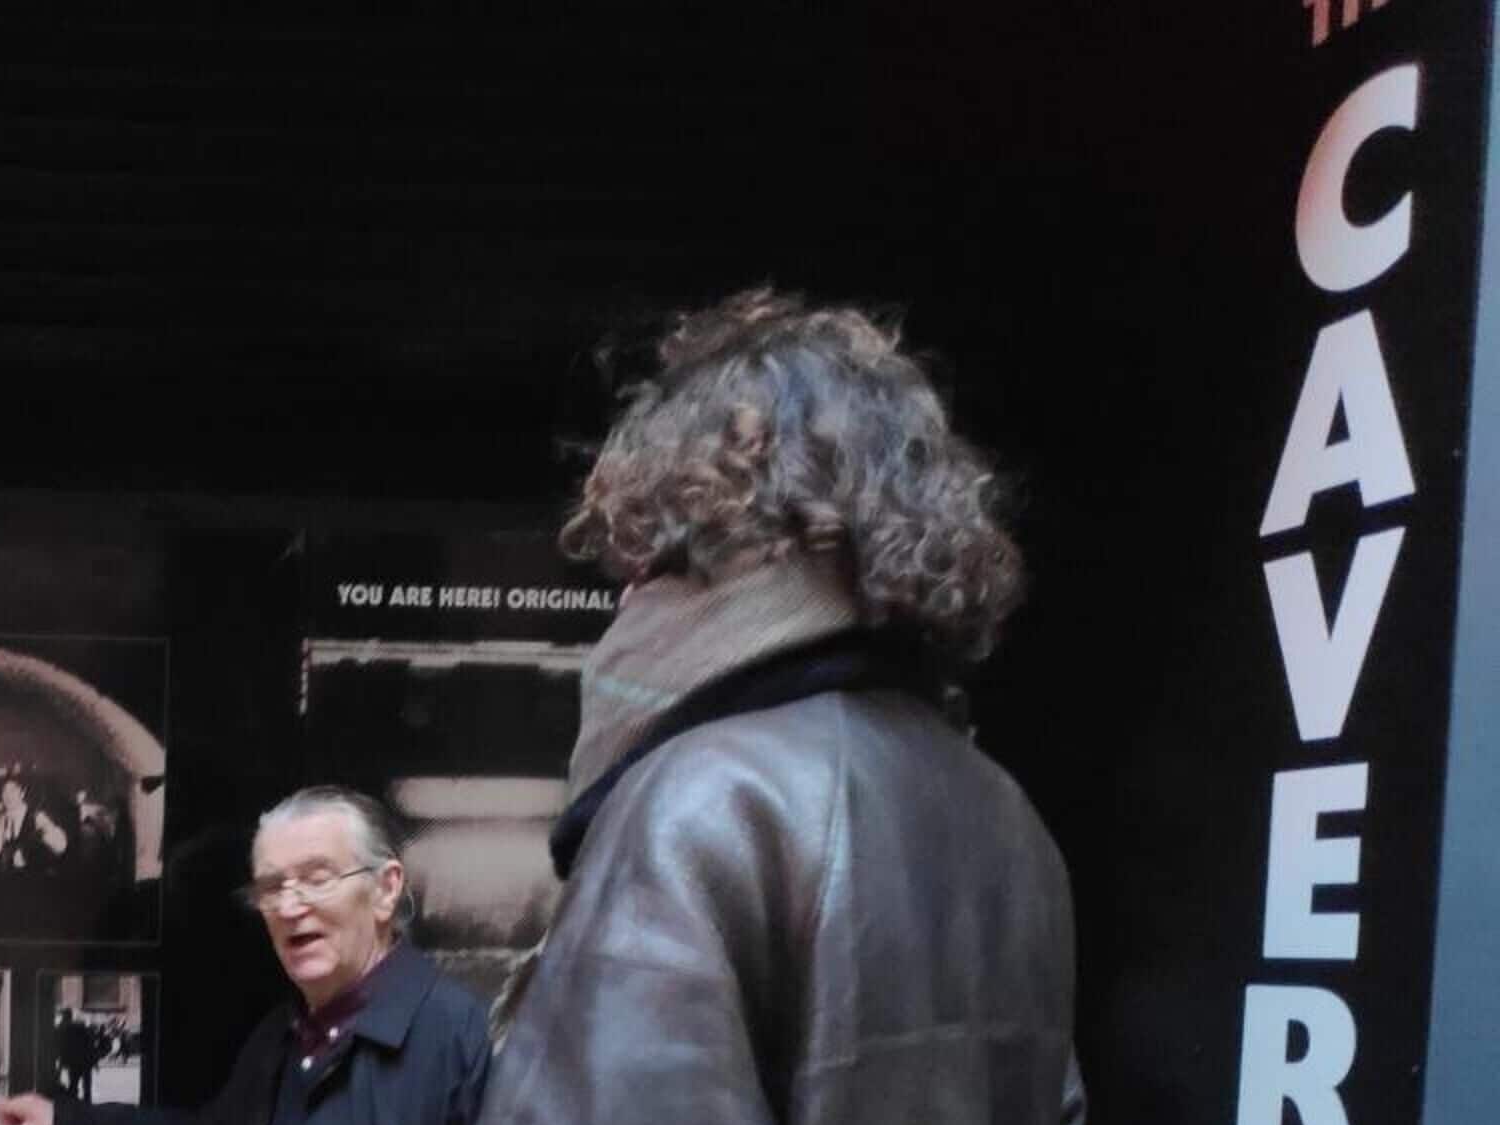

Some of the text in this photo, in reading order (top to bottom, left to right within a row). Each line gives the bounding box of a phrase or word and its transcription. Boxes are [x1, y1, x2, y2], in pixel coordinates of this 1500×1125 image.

[337, 583, 615, 611] YOU ARE HERE! ORIGINAL
